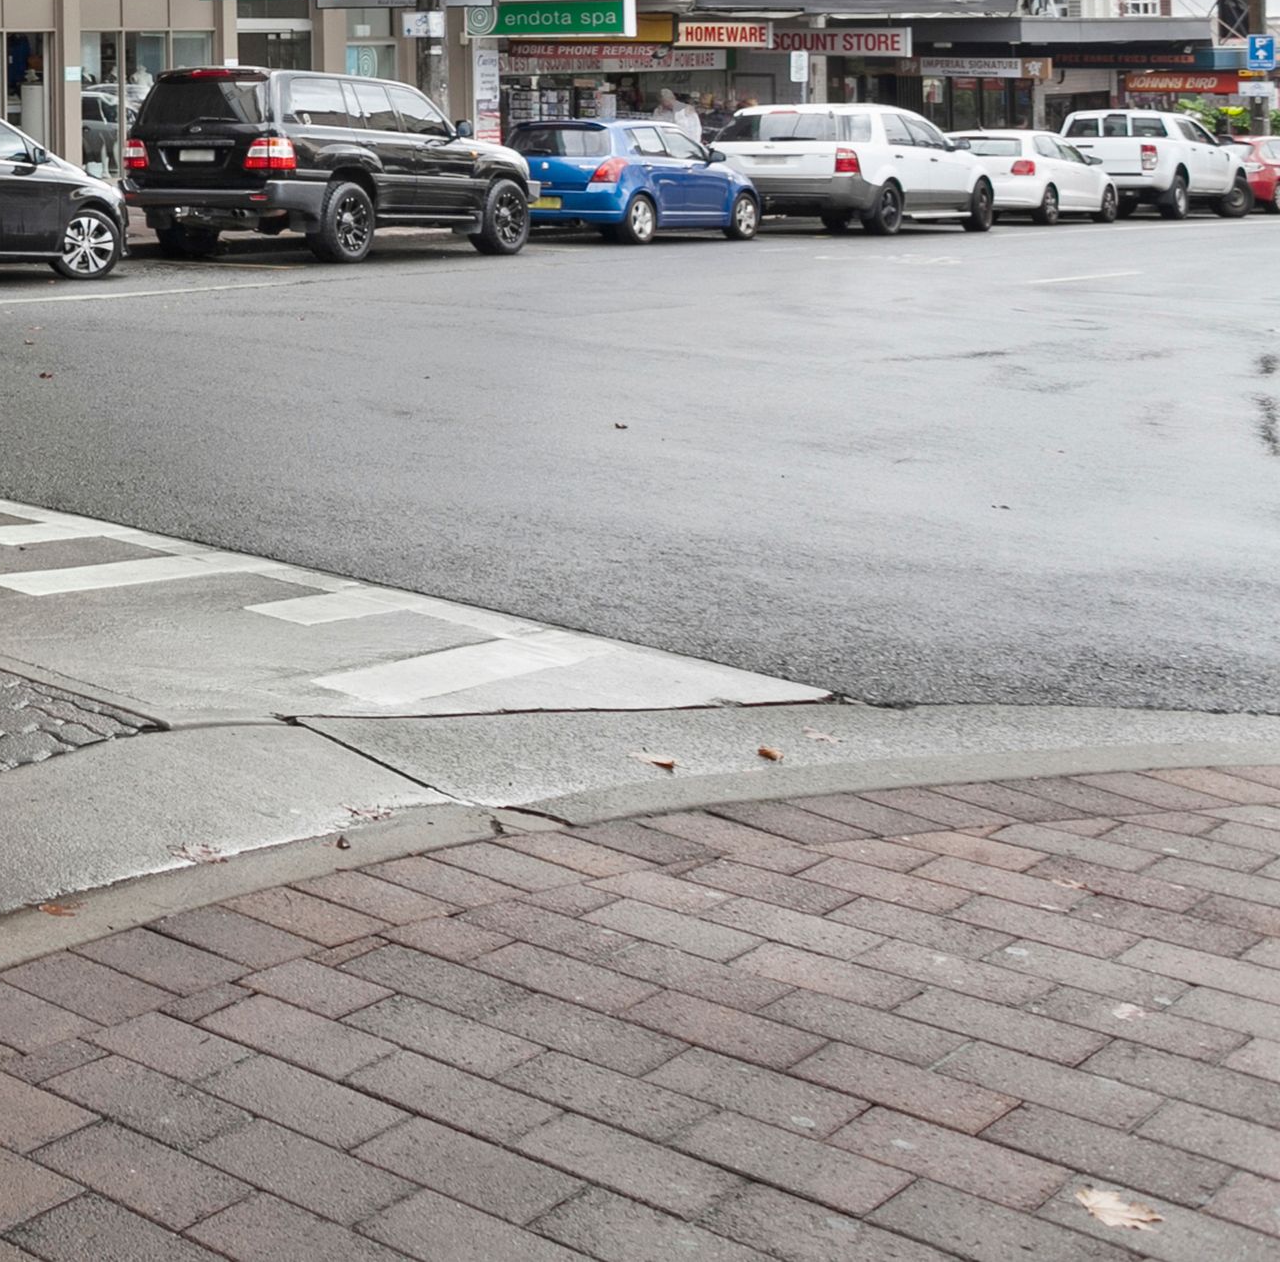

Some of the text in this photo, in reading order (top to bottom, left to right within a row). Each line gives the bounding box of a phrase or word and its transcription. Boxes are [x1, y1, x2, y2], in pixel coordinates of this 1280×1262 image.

[504, 10, 617, 27] endota spa
[685, 25, 767, 43] HOMEWARE
[772, 32, 901, 52] SCOUNT STORE
[512, 45, 653, 56] MOBILE PHONE REPAIRS
[923, 59, 1019, 70] IMPERIAL SIGNATURE
[1128, 76, 1218, 89] JOHNNY BIRD
